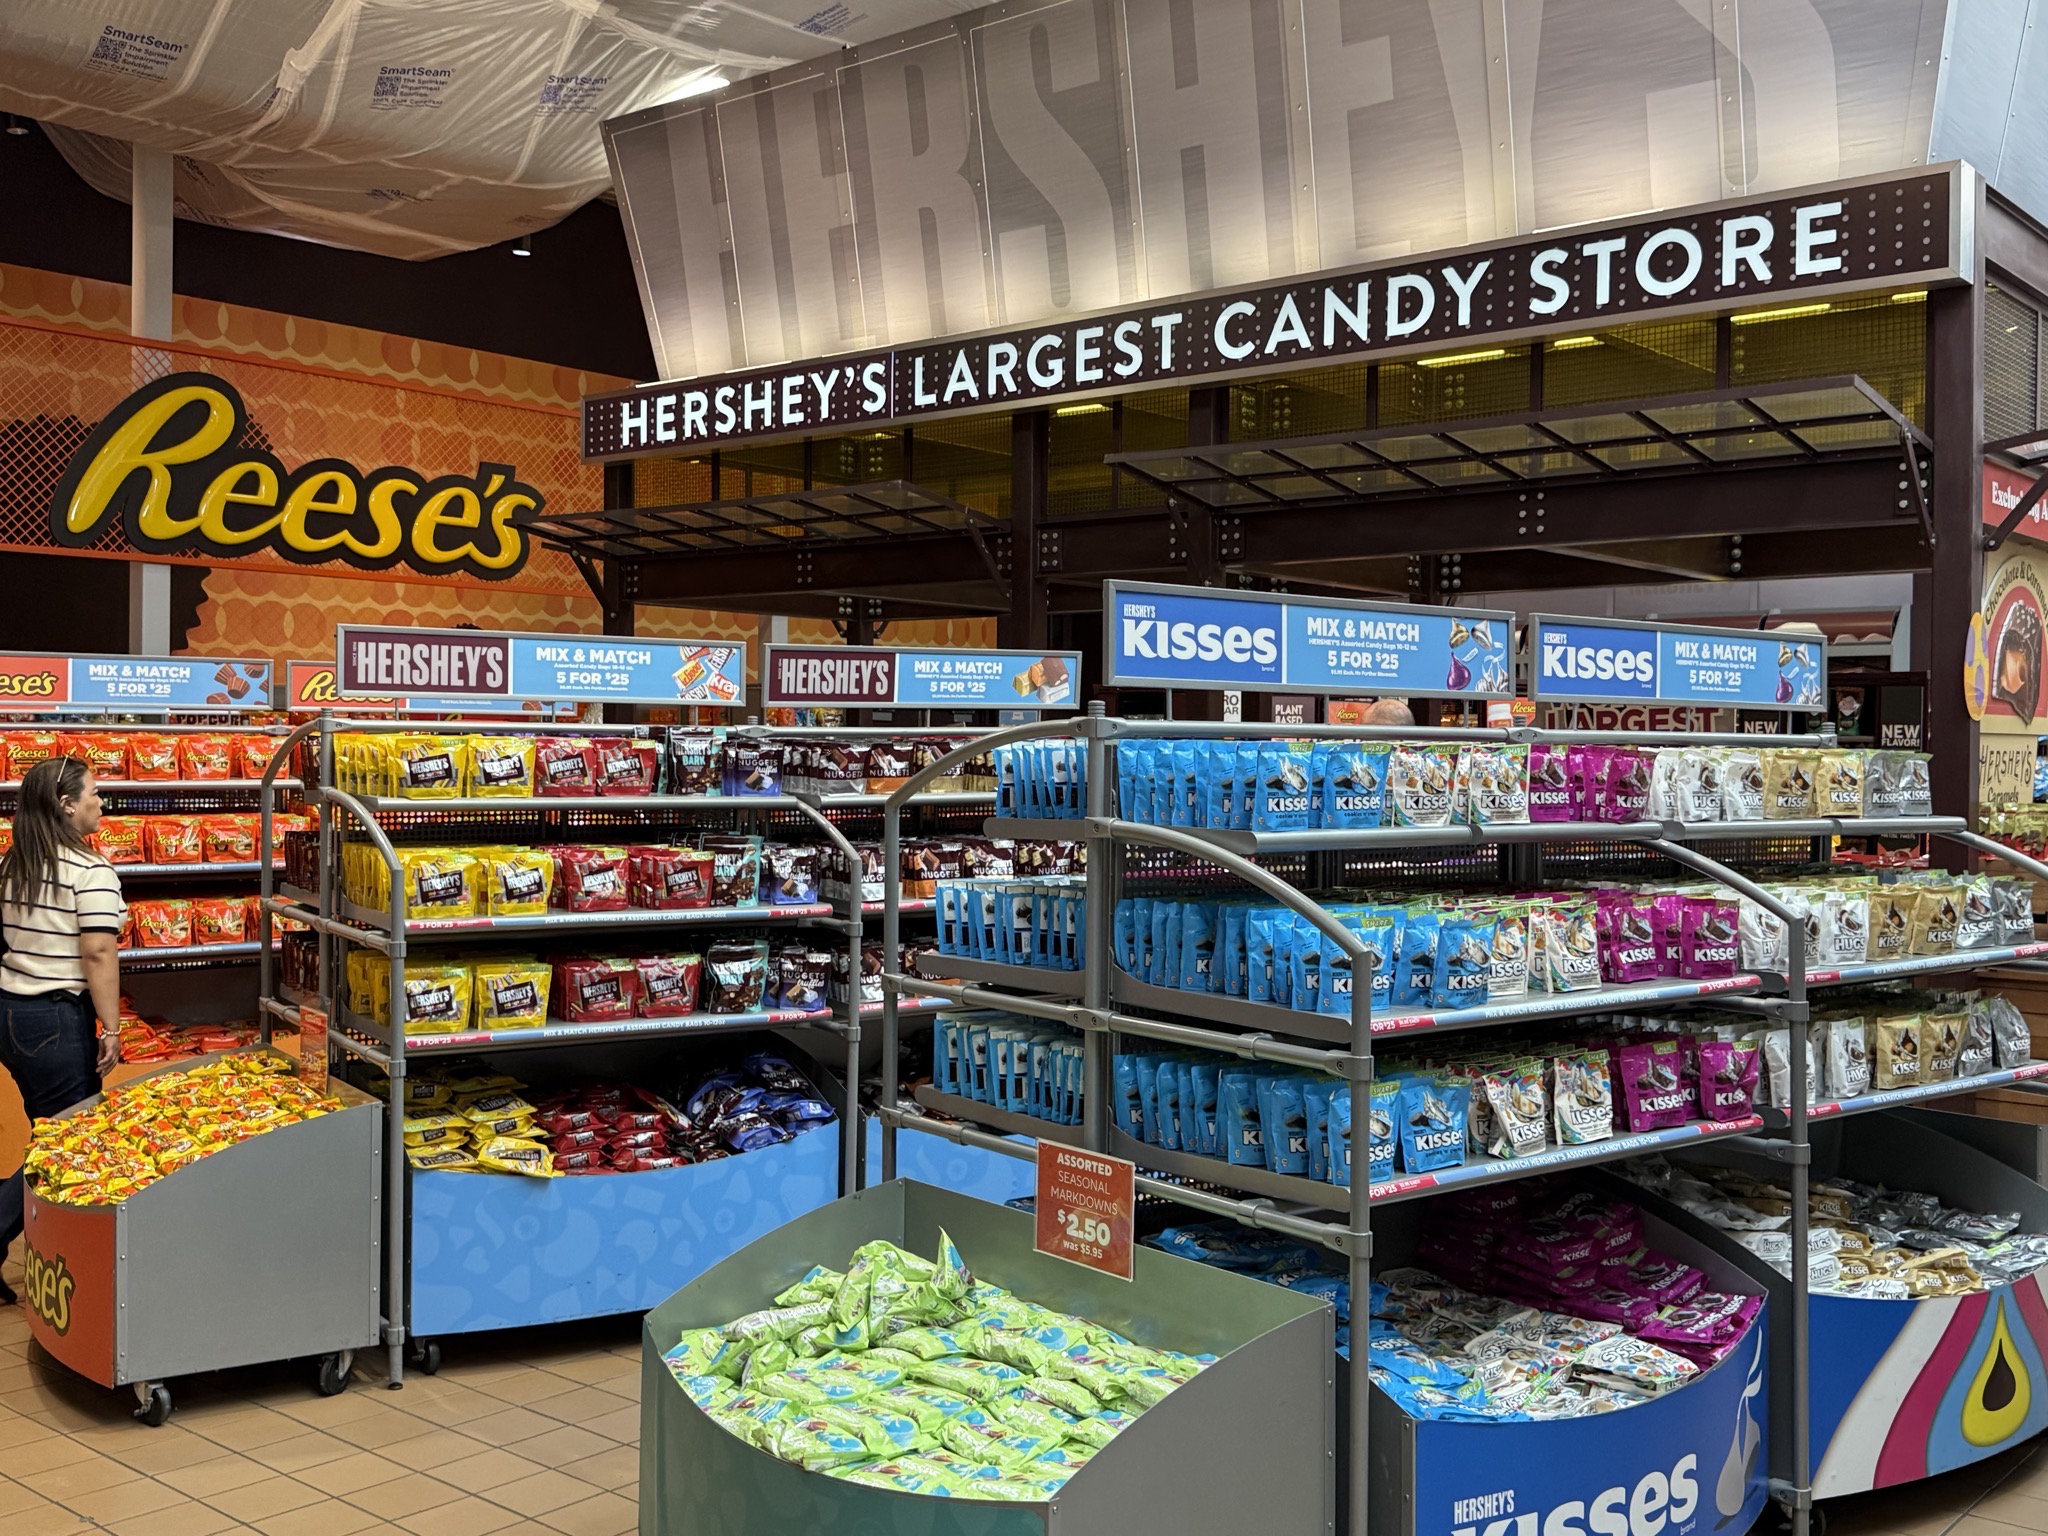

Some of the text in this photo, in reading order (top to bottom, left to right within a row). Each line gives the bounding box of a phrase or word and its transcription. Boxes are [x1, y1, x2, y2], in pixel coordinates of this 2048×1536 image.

[621, 202, 1843, 447] HERSHEY'S LARGEST CANDY STORE
[67, 386, 537, 569] Reese's
[1985, 566, 2019, 625] Chocolate
[1123, 603, 1156, 619] HERSHEY'S
[1307, 616, 1420, 642] MIX & MATCH
[1341, 640, 1364, 648] Assorted
[1365, 641, 1382, 649] Candy
[1383, 642, 1396, 650] Bags
[1543, 633, 1567, 645] HERSHEY'S
[536, 647, 651, 664] MIX & MATCH
[1675, 641, 1757, 662] MIX & MATCH
[357, 641, 503, 688] HERSHEY'S
[1327, 650, 1399, 670] 5 FOR $25
[89, 664, 190, 678] MIX & MATCH
[914, 661, 1003, 675] MIX & MATCH
[556, 672, 630, 686] 5 FOR $25
[781, 658, 889, 695] HERSHEY'S
[1689, 670, 1741, 686] 5 FOR $25
[107, 684, 171, 694] 5 FOR $25
[930, 681, 986, 693] 5 FOR $25
[1275, 704, 1303, 715] PLANT
[1275, 716, 1303, 724] BASED
[1545, 706, 1720, 732] LARGEST
[1745, 720, 1778, 732] NEW
[1882, 724, 1920, 738] NEW
[1882, 738, 1920, 747] FLAVOR!
[7, 745, 50, 758] Reese's
[85, 745, 124, 760] Reese's
[411, 758, 449, 774] HERSHEY'S
[482, 756, 521, 772] HERSHEY'S
[549, 758, 584, 773] HERSHEY'S
[607, 758, 641, 773] HERSHEY'S
[682, 754, 706, 765] BARK
[738, 759, 778, 767] NUGGETS
[1979, 744, 2032, 789] HERSHEY'S
[824, 770, 863, 779] NUGGETS
[870, 768, 910, 777] NUGGETS
[1987, 785, 2019, 803] Caramels
[99, 829, 138, 844] Reese's
[668, 870, 697, 886] HERSHEY'S
[921, 870, 961, 880] NUGGETS
[972, 867, 1014, 875] NUGGETS
[422, 874, 461, 891] HERSHEY'S
[507, 872, 540, 889] HERSHEY'S
[1505, 908, 1526, 916] SHARE
[1366, 918, 1390, 927] SHARE
[781, 970, 825, 980] NUGGETS
[583, 980, 618, 998] HERSHEY'S
[650, 977, 682, 993] HERSHEY'S
[1332, 974, 1390, 993] Kies
[410, 991, 450, 1006] HERSHEY'S
[498, 988, 533, 1004] HERSHEY'S
[1485, 1009, 1497, 1018] MIX
[1505, 1006, 1528, 1016] MATCH
[1563, 999, 1597, 1008] ASSORTED
[1598, 996, 1618, 1005] CANDY
[626, 1023, 661, 1031] ASSORTED
[663, 1021, 684, 1029] CANDY
[685, 1020, 703, 1028] BAGS
[1521, 1065, 1542, 1075] SHARE
[1372, 1085, 1394, 1095] SHARE
[1484, 1163, 1498, 1173] MIX
[1505, 1159, 1530, 1171] MATCH
[1531, 1152, 1566, 1166] HERSHEY'S
[1567, 1147, 1600, 1160] ASSORTED
[1600, 1143, 1621, 1154] CANDY
[1622, 1140, 1638, 1151] BAGS
[1057, 1153, 1112, 1177] ASSORTED
[1058, 1170, 1111, 1195] SEASONAL
[1051, 1186, 1118, 1215] MARKDOWNS
[1057, 1209, 1110, 1246] $2.50
[1063, 1240, 1103, 1259] was $5.95
[1808, 1238, 1831, 1252] HUGS
[1810, 1264, 1834, 1279] HUGS
[1454, 1489, 1514, 1524] HERSHEY'S
[1680, 1520, 1696, 1535] brand
